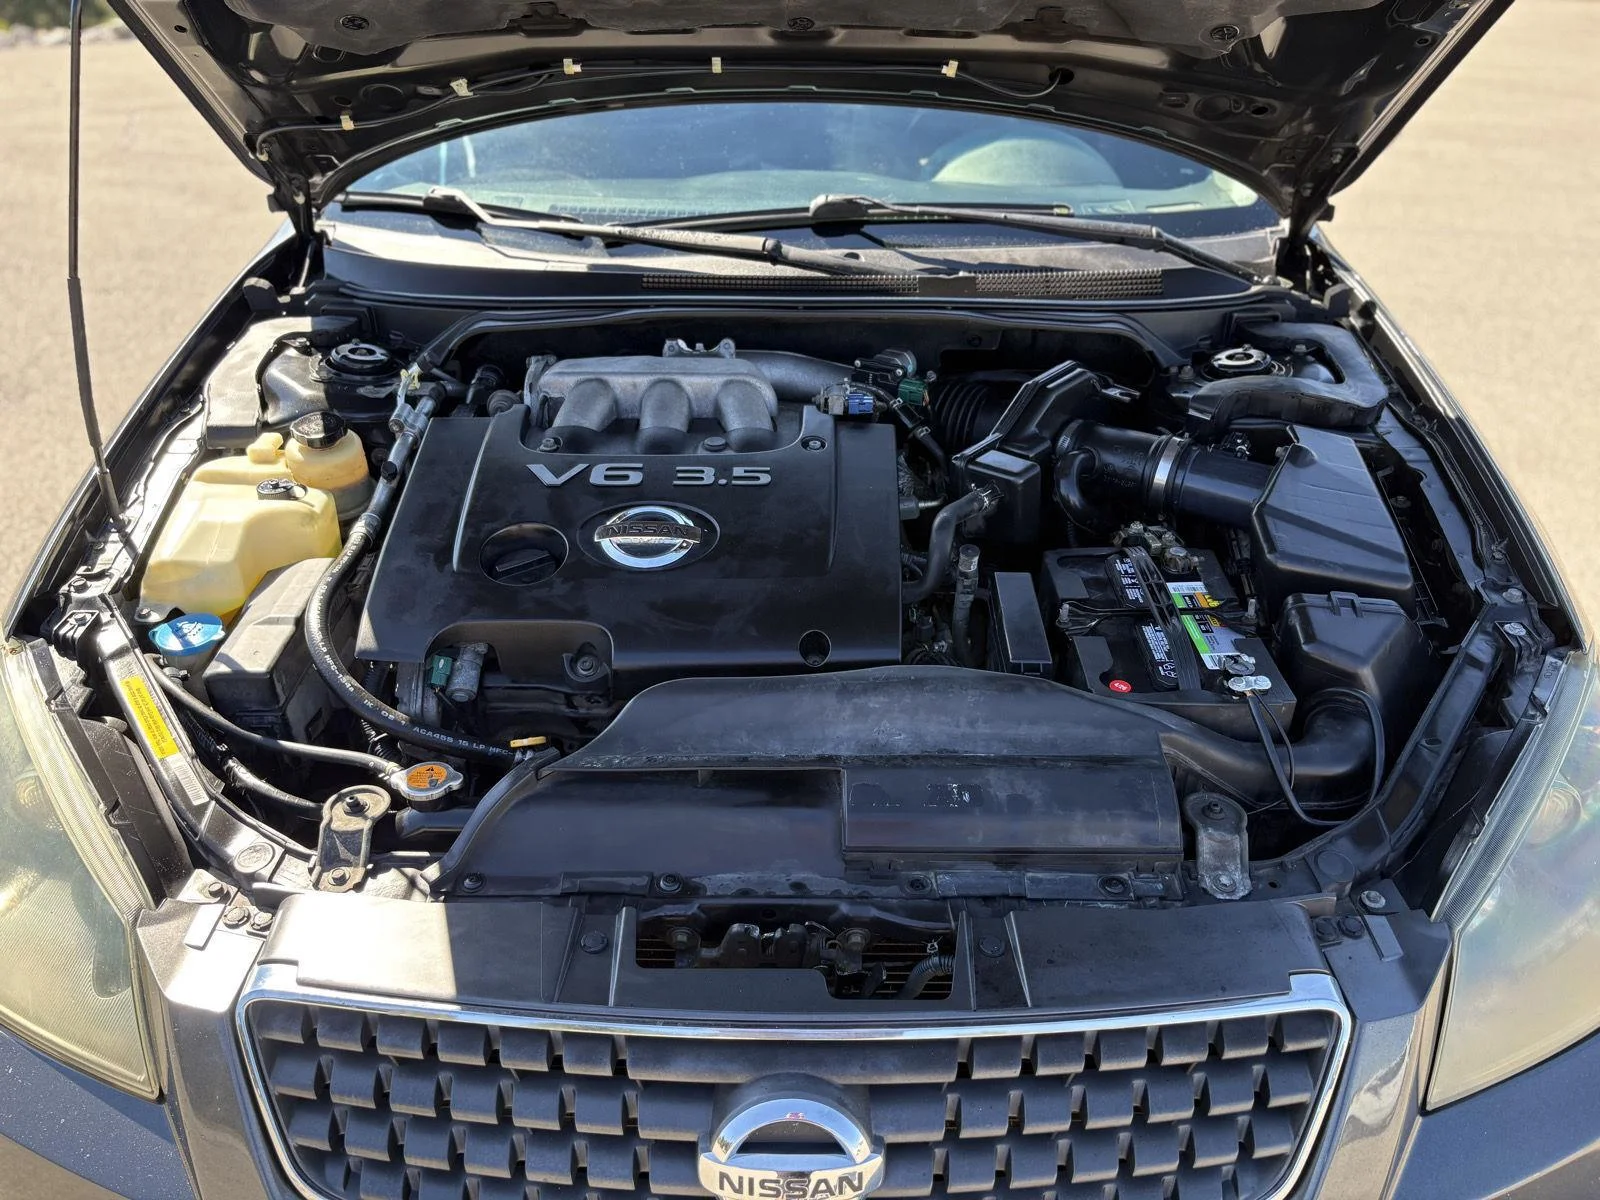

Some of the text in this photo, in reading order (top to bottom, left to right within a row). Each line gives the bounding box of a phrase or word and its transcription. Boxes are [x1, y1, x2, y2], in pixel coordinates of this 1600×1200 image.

[525, 463, 772, 487] V6 3.5
[608, 523, 688, 537] NISSAN
[472, 742, 486, 750] LP
[718, 1171, 864, 1200] NISSAN
